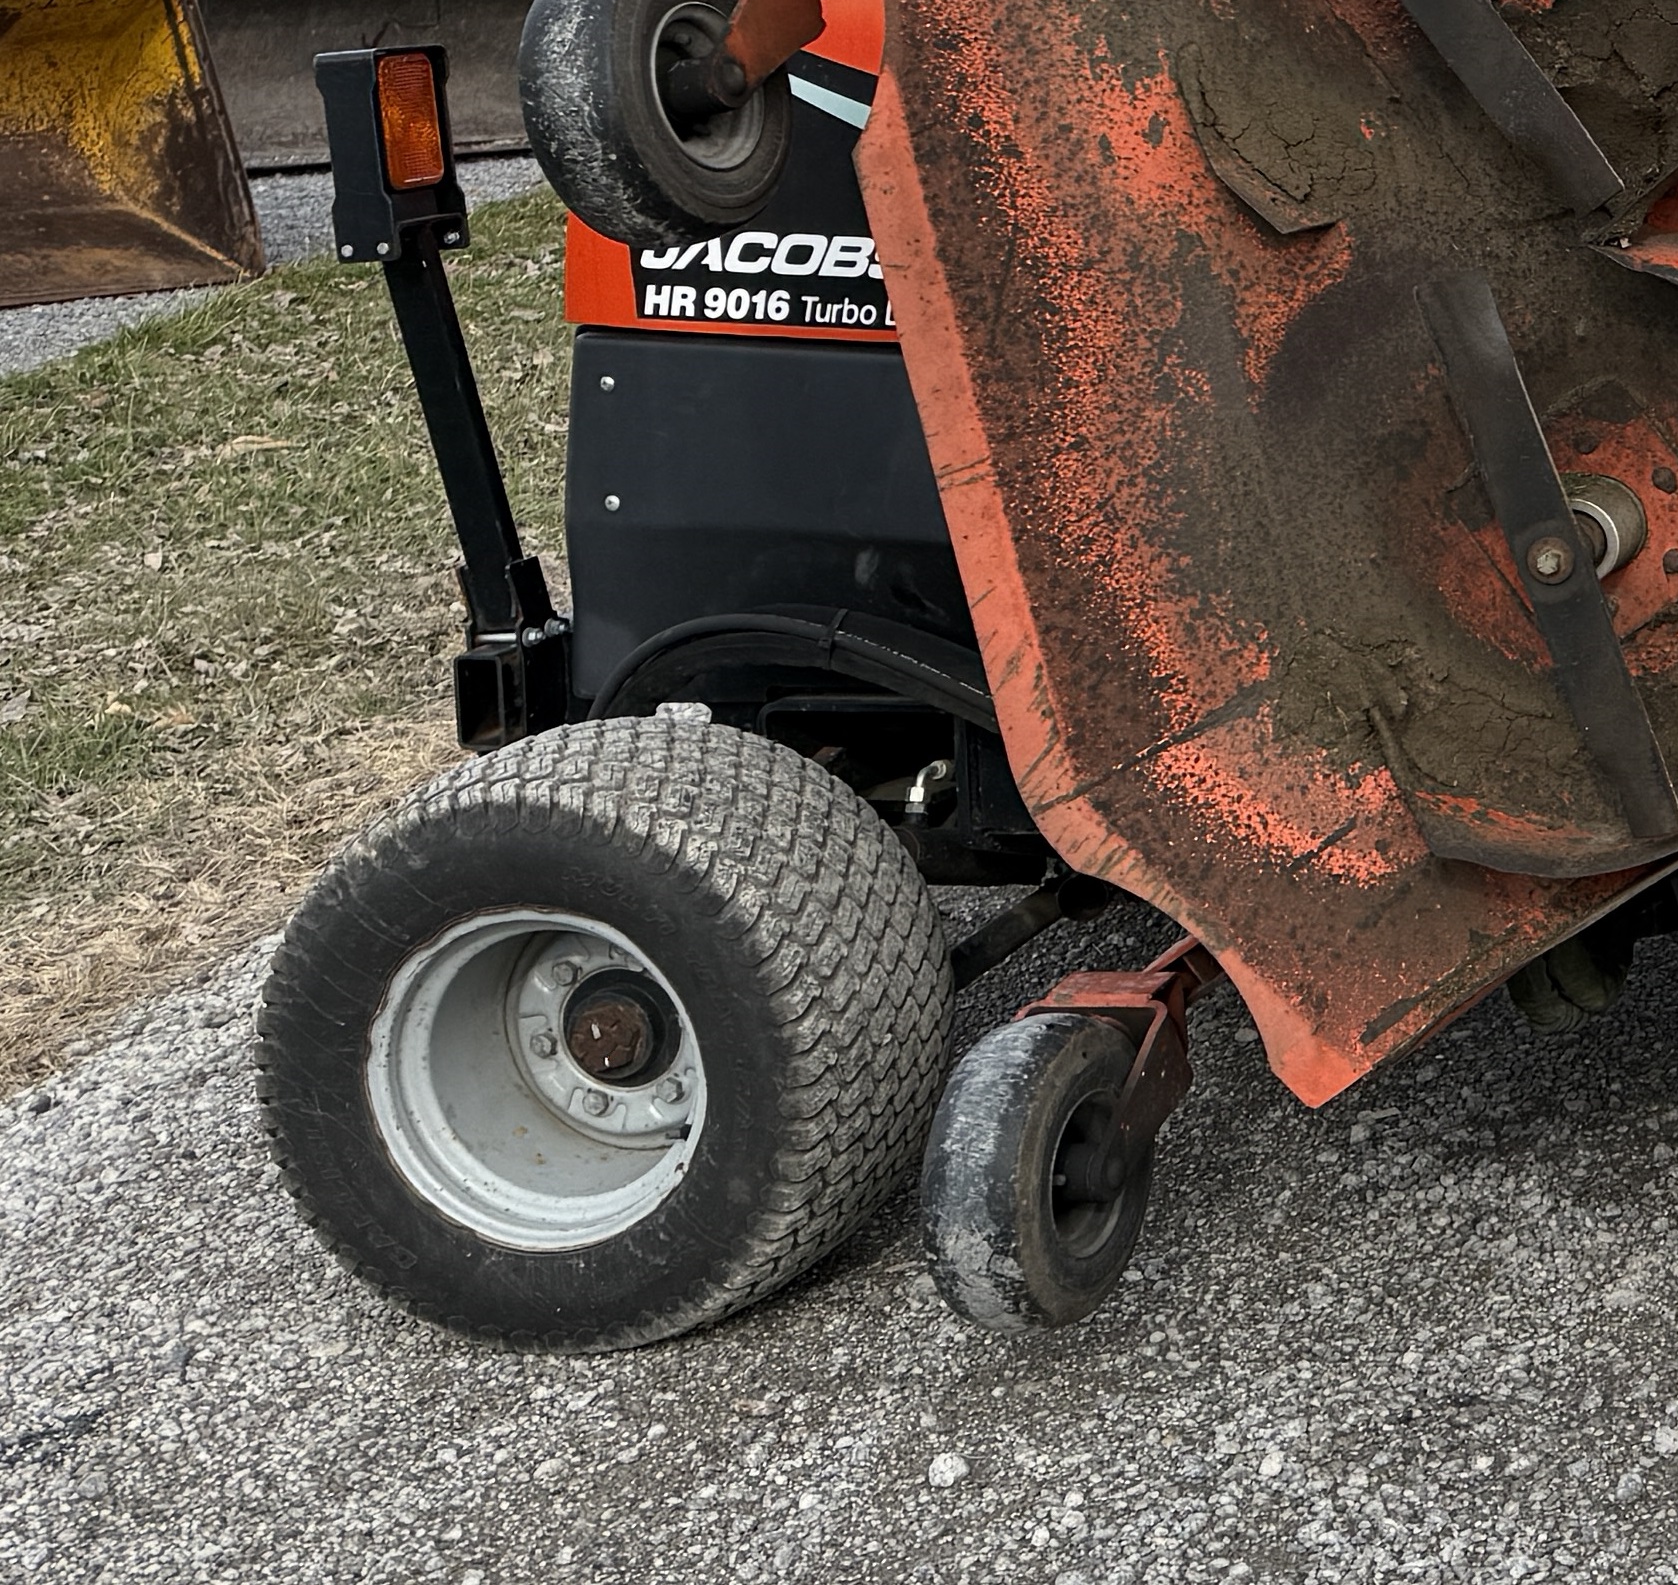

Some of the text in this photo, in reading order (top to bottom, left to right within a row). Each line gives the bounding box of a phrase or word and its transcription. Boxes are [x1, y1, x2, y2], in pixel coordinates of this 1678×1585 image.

[639, 230, 884, 279] JACOB
[643, 284, 697, 318] HR
[703, 286, 791, 321] 9016
[801, 295, 877, 326] Turbo
